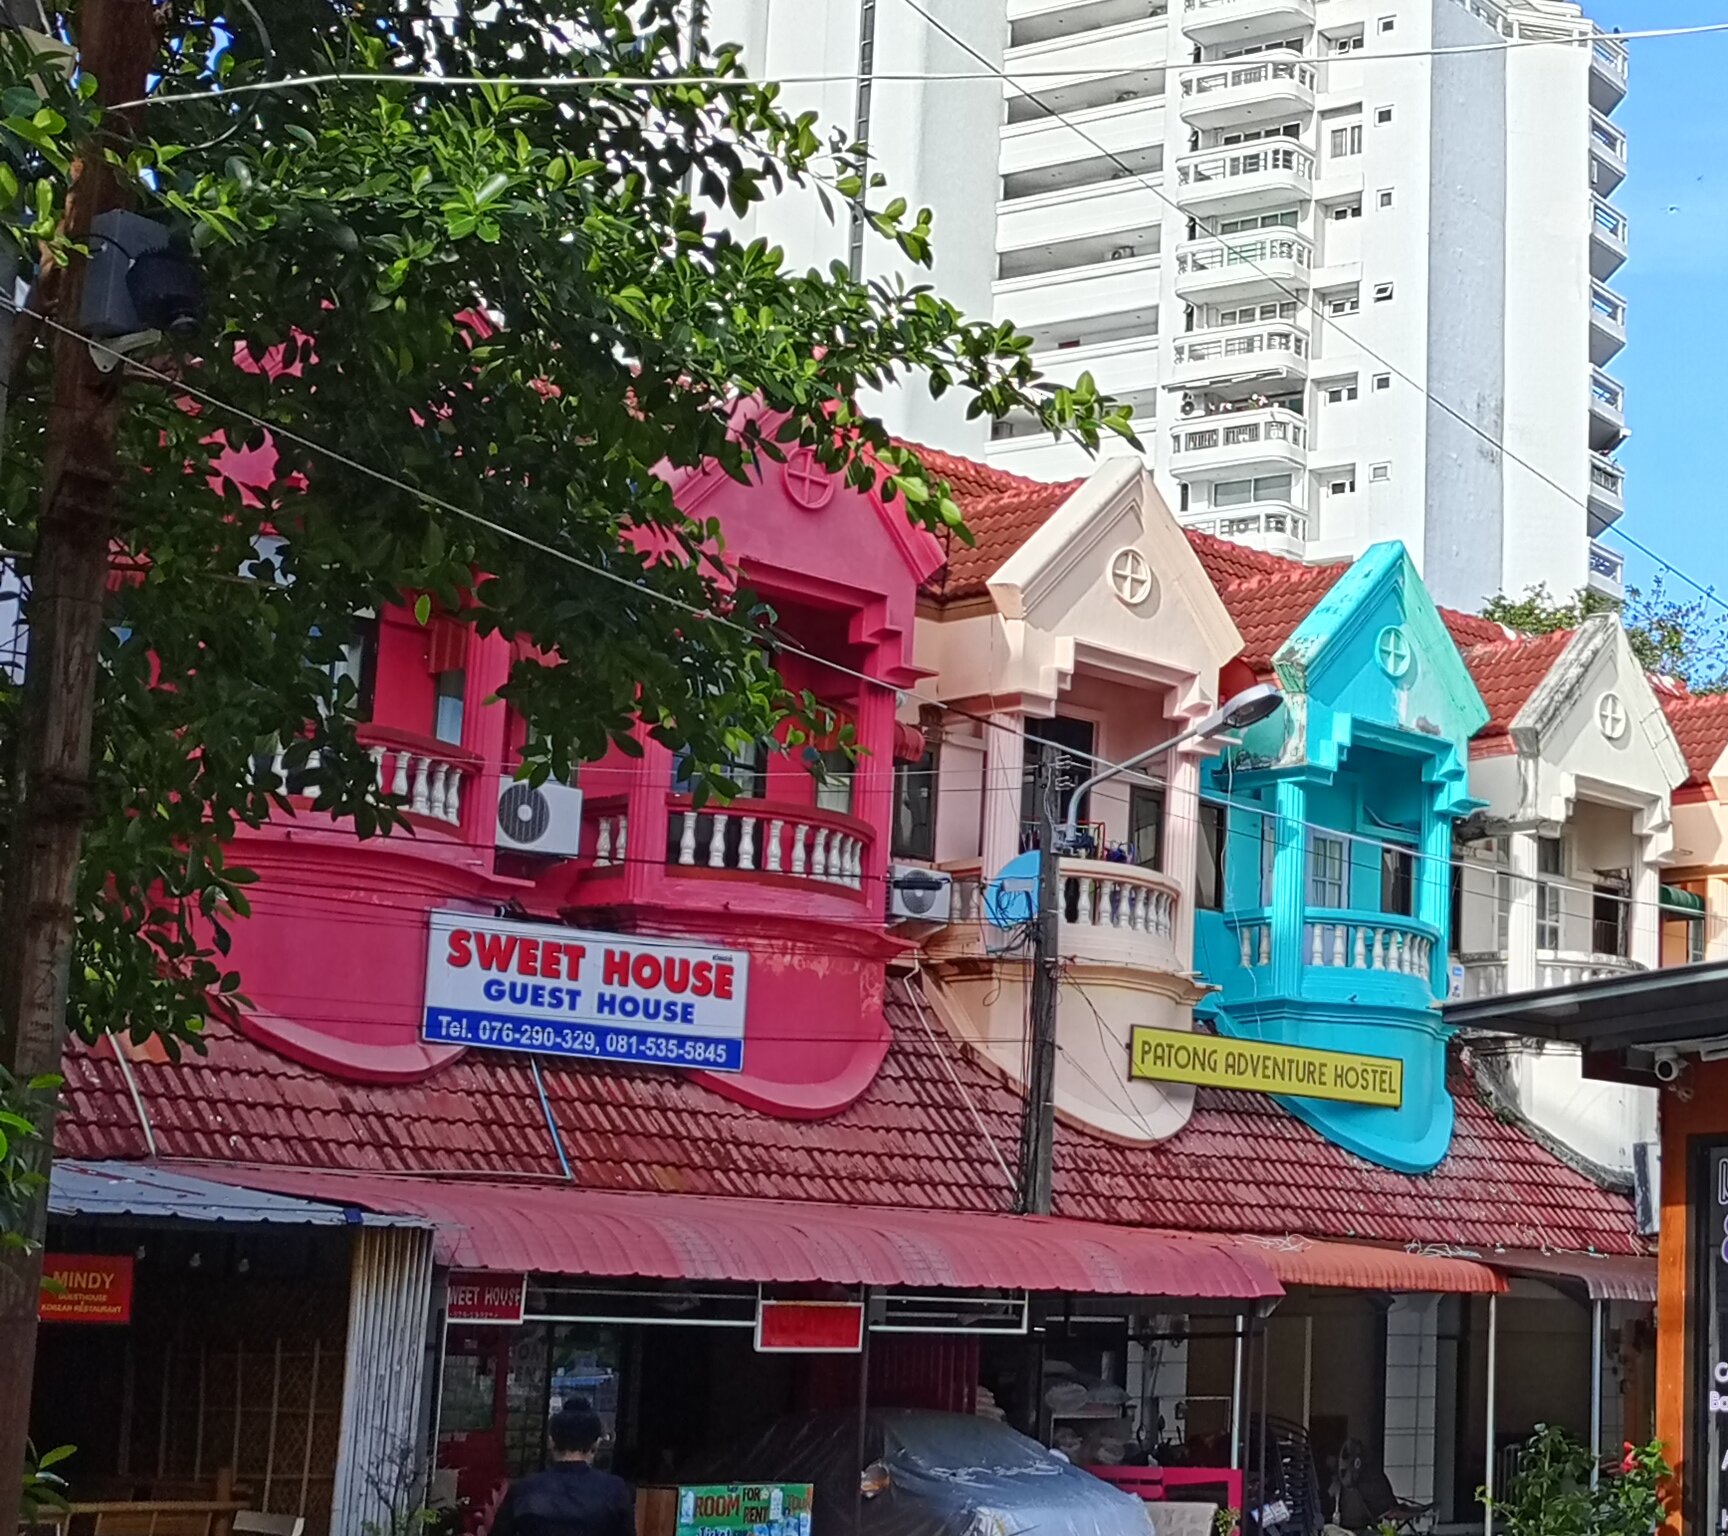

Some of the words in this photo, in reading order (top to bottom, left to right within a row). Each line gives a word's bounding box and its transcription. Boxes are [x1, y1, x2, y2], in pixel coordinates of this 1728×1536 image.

[447, 928, 586, 982] SWEET
[602, 948, 735, 1000] HOUSE
[483, 979, 582, 1011] GUEST
[597, 992, 695, 1024] HOUSE
[437, 1015, 471, 1040] Tel.
[478, 1020, 600, 1056] 076-290-329,
[606, 1034, 727, 1064] 081-535-5845
[1140, 1040, 1218, 1073] PATONG
[1224, 1051, 1327, 1086] ADVENTURE
[1334, 1064, 1397, 1094] HOSTEL
[52, 1271, 115, 1289] MINDY
[695, 1495, 741, 1517] ROOM
[742, 1487, 761, 1502] FOR
